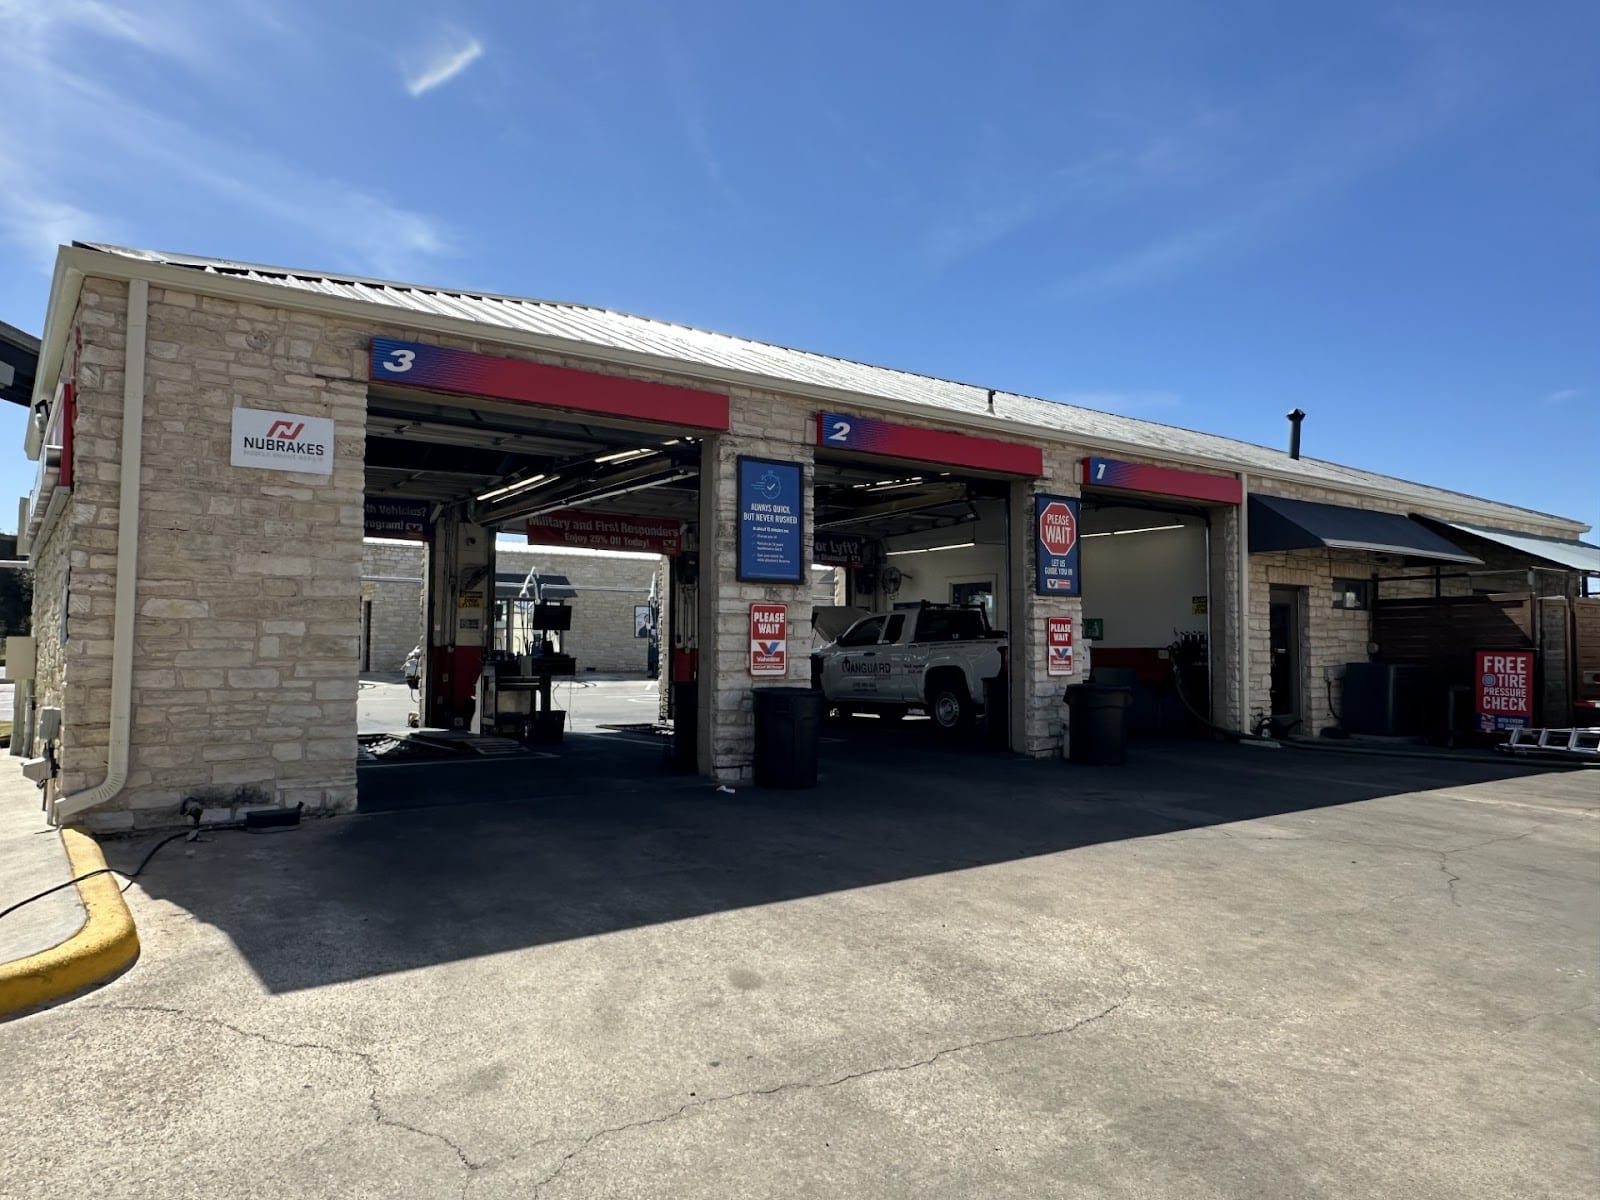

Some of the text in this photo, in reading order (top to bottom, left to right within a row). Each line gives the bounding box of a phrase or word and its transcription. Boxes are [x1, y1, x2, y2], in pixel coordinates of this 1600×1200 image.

[383, 350, 415, 372] 3
[828, 422, 850, 441] 2
[244, 437, 324, 455] NUBRAKES
[1096, 464, 1106, 479] 1
[379, 505, 427, 517] Vehicles?
[751, 503, 772, 513] ALWAYS
[743, 512, 798, 524] BUT NEVER RUSHED
[1047, 513, 1070, 526] PLEASE
[365, 520, 404, 530] rogram!
[528, 515, 679, 537] Military and First Responders
[565, 533, 588, 544] Enjoy
[610, 536, 622, 545] Off
[624, 536, 650, 549] Today!
[1045, 525, 1072, 544] WAIT
[830, 540, 858, 556] Lyft?
[1051, 559, 1059, 567] LET
[754, 612, 785, 623] PLEASE
[758, 623, 780, 634] WAIT
[1051, 623, 1071, 633] PLEASE
[1053, 633, 1069, 641] WAIT
[842, 662, 891, 674] VANGUARD
[1483, 655, 1527, 674] FREE
[1497, 674, 1527, 688] TIRE
[1483, 687, 1527, 698] PRESSURE
[1483, 696, 1527, 711] CHECK
